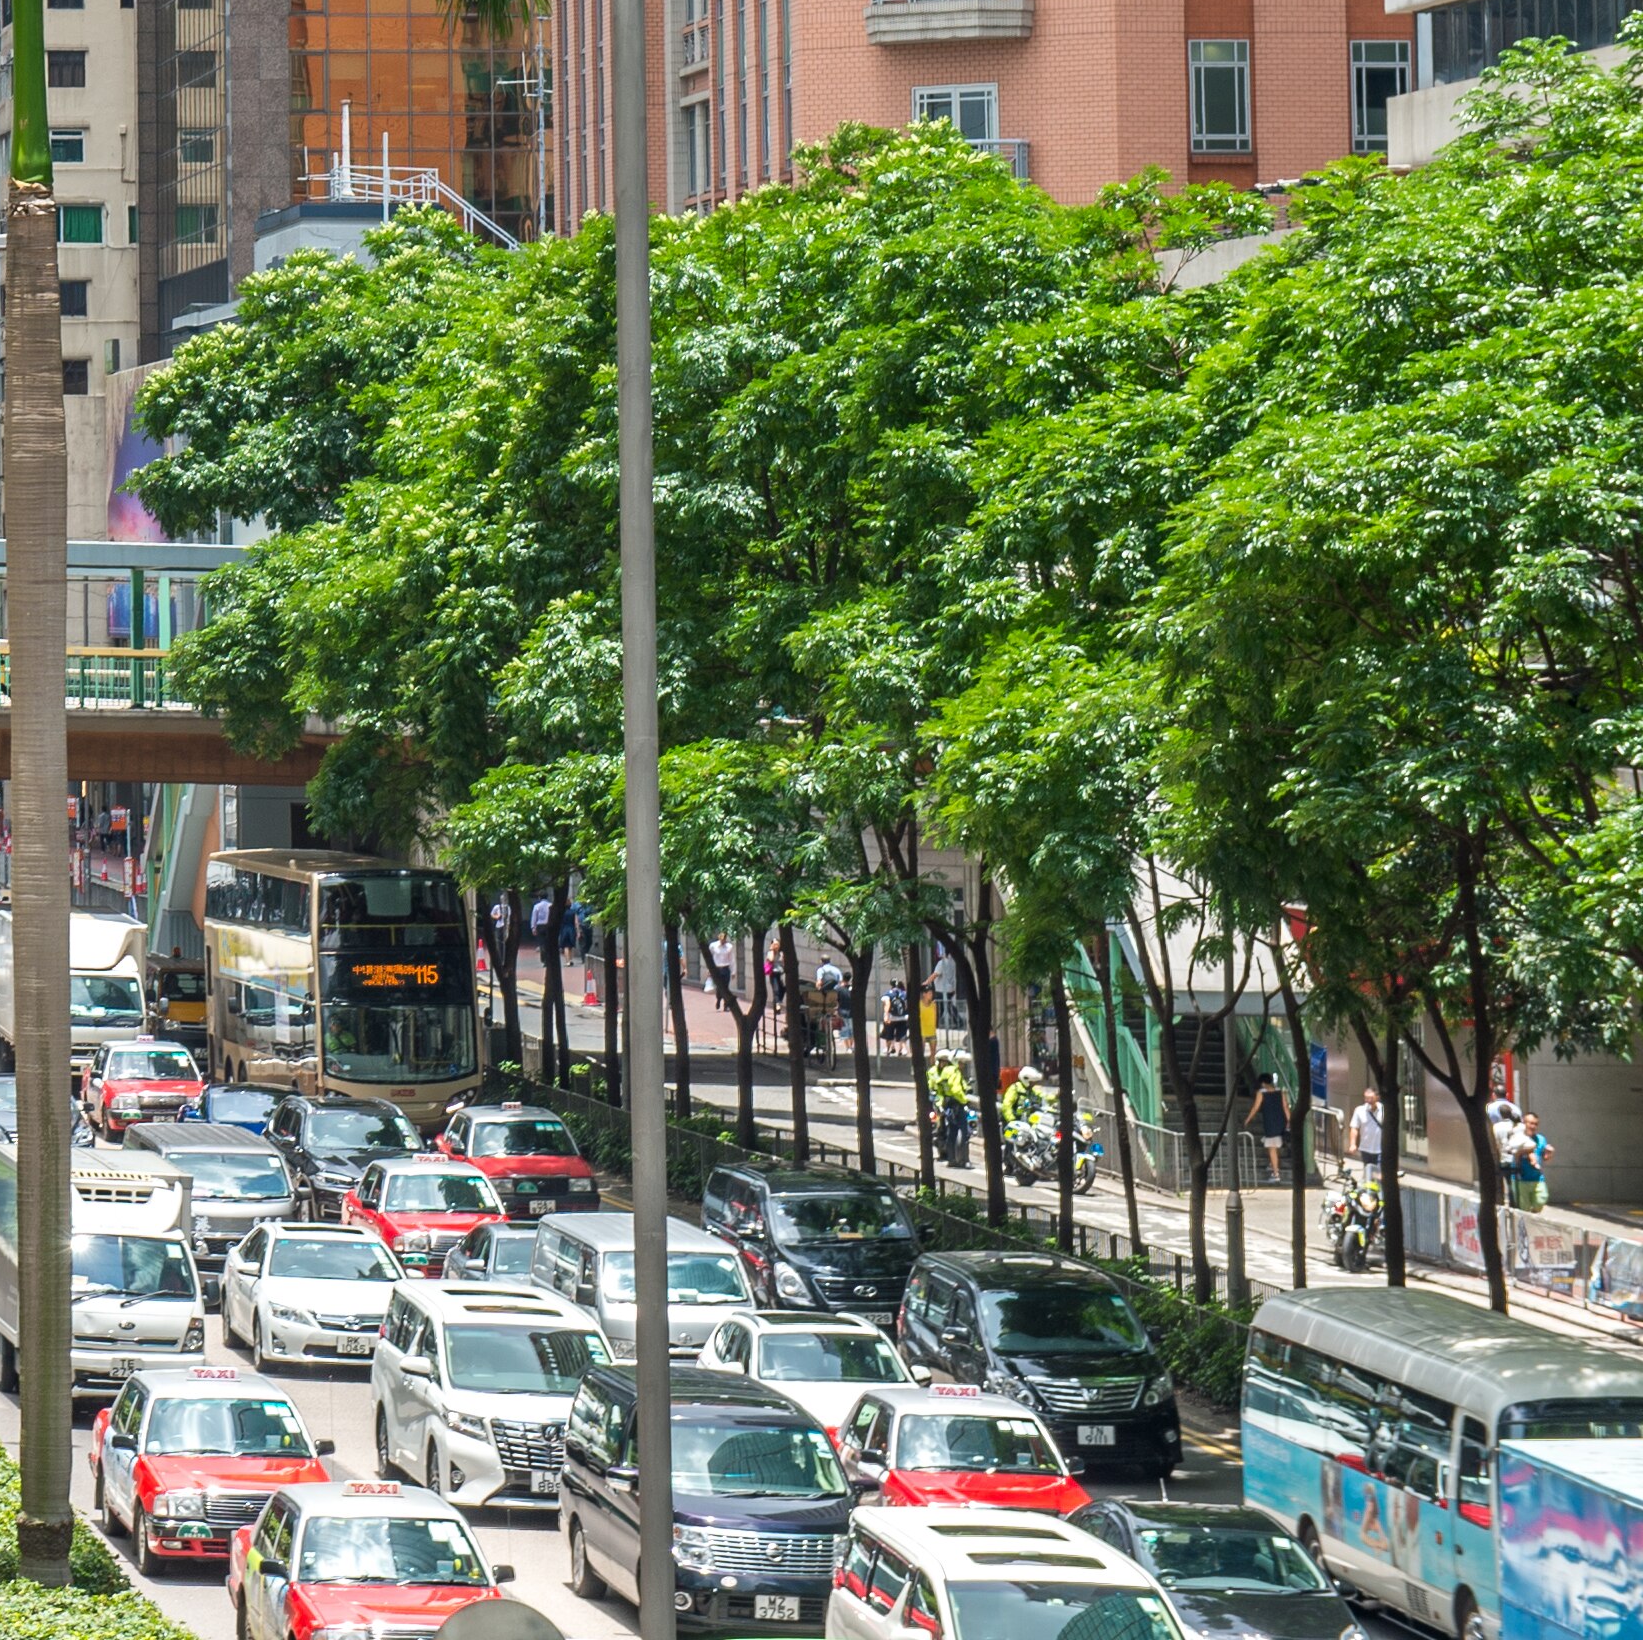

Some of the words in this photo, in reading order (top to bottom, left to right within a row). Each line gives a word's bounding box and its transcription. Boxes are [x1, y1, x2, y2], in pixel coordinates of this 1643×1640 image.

[417, 964, 439, 985] 115
[415, 1155, 448, 1163] TAXI
[192, 1369, 236, 1379] TAXI
[935, 1386, 978, 1396] TAXI
[350, 1484, 399, 1494] TAXI
[768, 1596, 786, 1609] MZ
[759, 1608, 795, 1619] 3752
